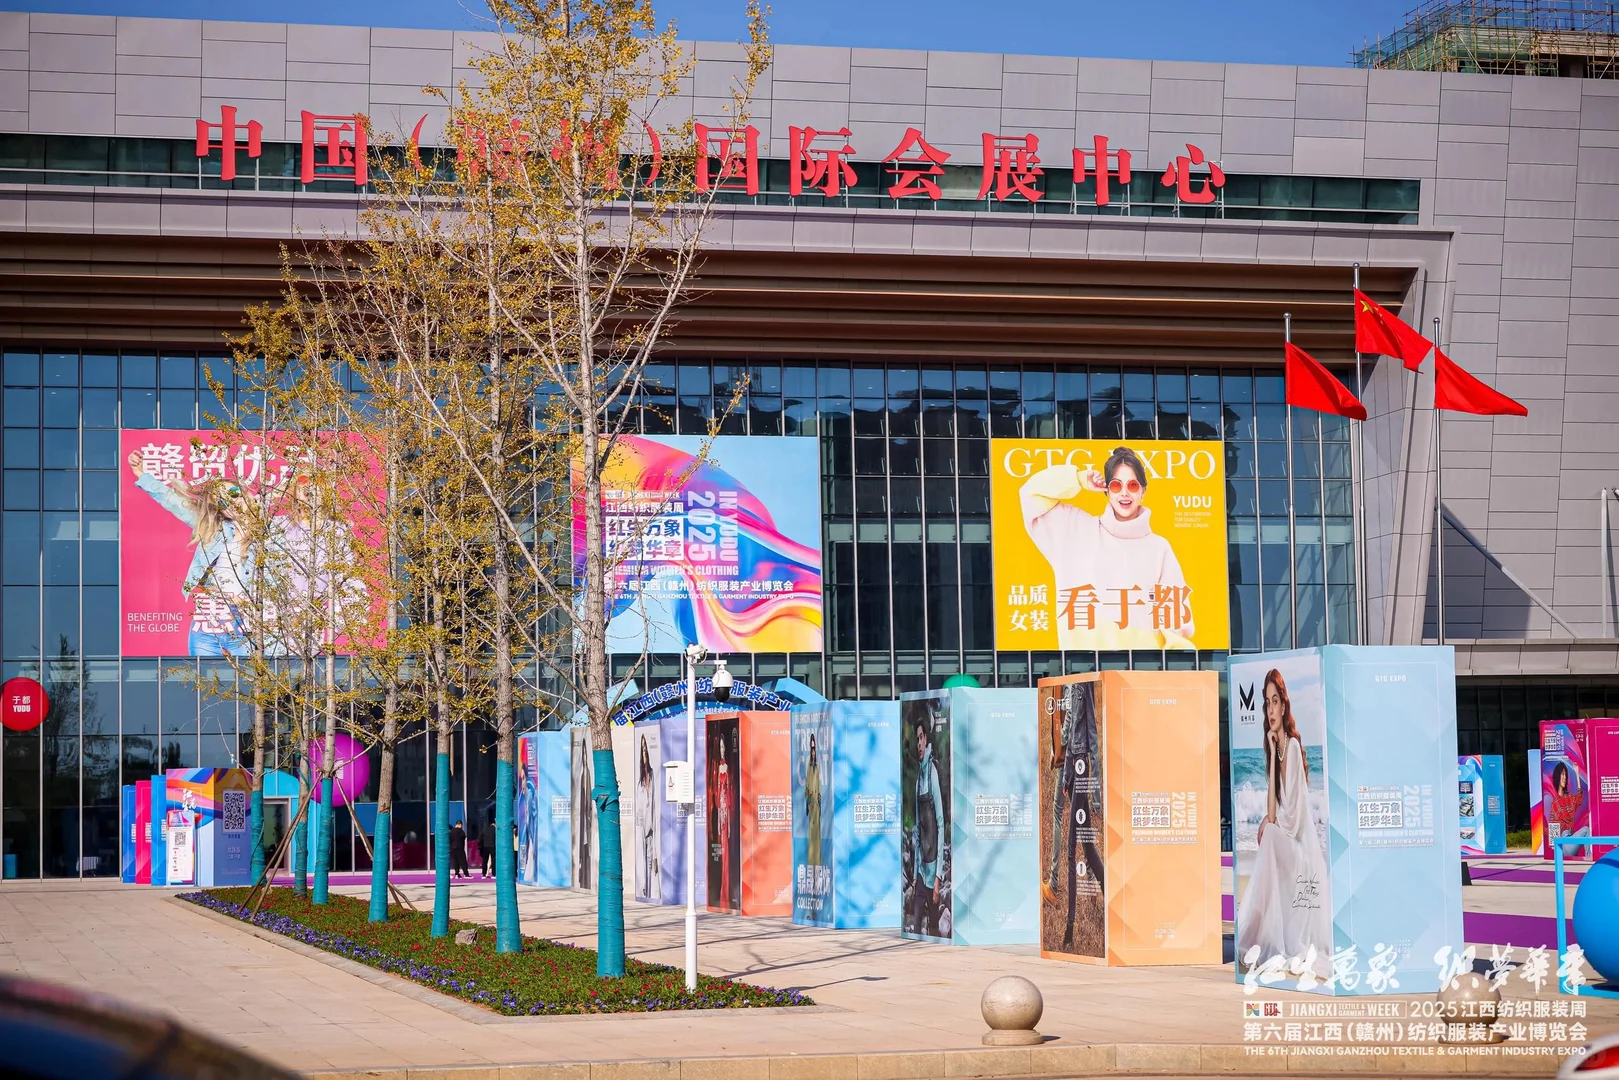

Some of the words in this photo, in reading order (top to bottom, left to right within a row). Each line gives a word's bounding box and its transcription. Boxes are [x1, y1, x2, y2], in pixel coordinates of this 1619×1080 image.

[1108, 449, 1216, 479] XPO
[719, 490, 739, 509] IN
[1172, 495, 1212, 508] YUDU
[688, 491, 717, 561] 2025
[719, 513, 739, 562] YUDU
[695, 565, 739, 576] CLOTHING
[1008, 584, 1048, 606] 品质
[127, 612, 183, 622] BENEFITING
[1057, 584, 1194, 630] 看于都
[127, 623, 146, 632] THE
[148, 623, 180, 633] GLOBE
[1008, 609, 1049, 632] 女装
[12, 695, 31, 705] 于都
[1171, 791, 1186, 828] 2025
[1403, 784, 1421, 828] 2025
